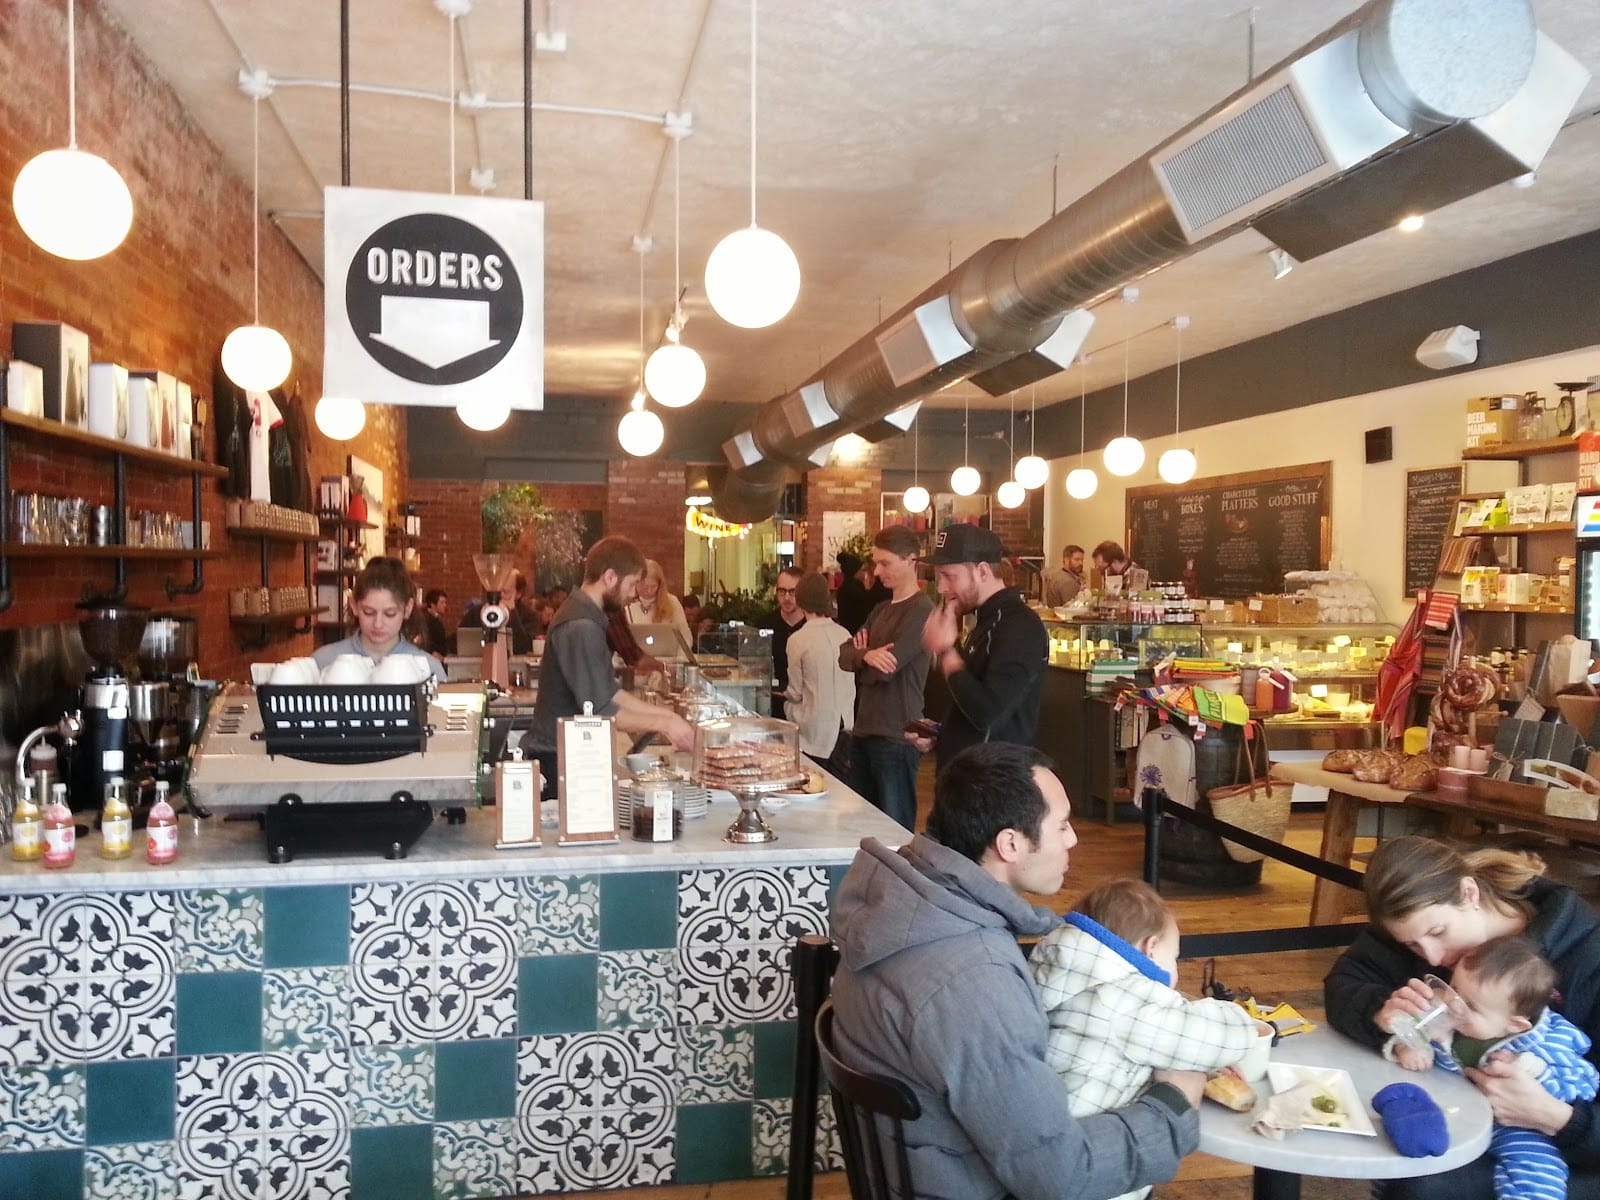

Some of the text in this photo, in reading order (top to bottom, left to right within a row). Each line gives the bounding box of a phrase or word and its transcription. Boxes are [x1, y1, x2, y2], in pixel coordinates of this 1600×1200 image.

[367, 247, 503, 291] ORDERS
[1467, 412, 1485, 424] BEER
[1467, 422, 1497, 435] MAKING
[1466, 436, 1479, 448] KIT
[1579, 477, 1592, 489] KIT
[1221, 498, 1259, 511] PLATTERS
[1268, 491, 1319, 507] GOOD STUFF
[695, 516, 732, 532] WINE
